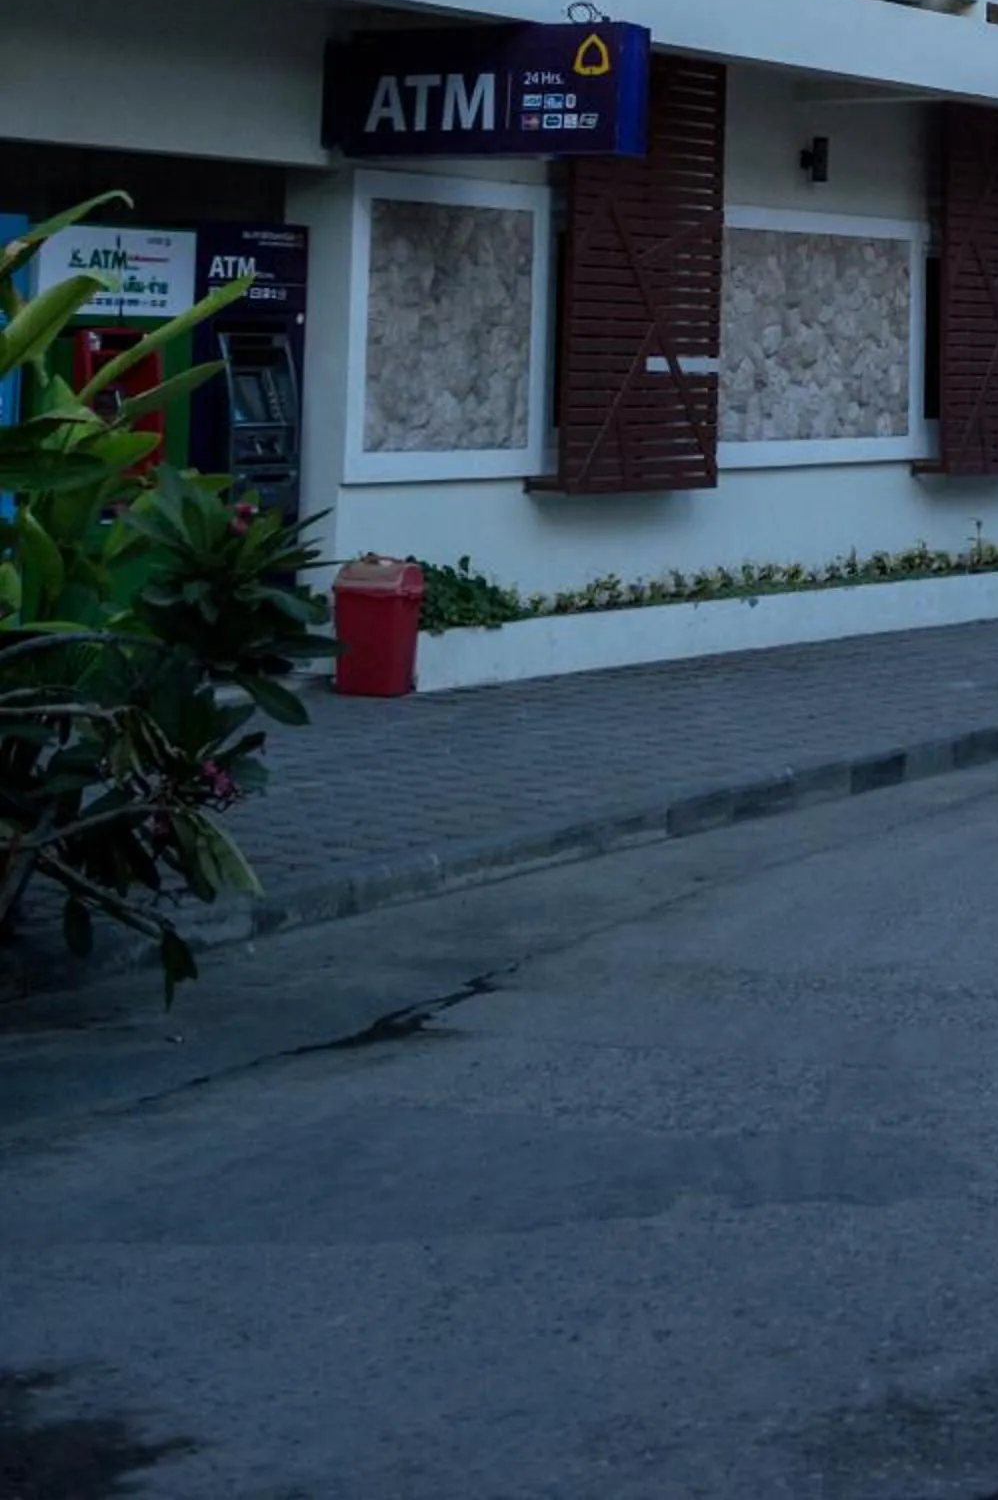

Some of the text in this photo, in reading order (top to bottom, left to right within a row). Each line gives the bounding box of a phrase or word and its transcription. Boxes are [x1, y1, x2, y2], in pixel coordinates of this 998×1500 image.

[523, 71, 564, 85] 24 Hrs.
[364, 73, 496, 132] ATM
[89, 249, 128, 270] ATM
[207, 255, 257, 279] ATM
